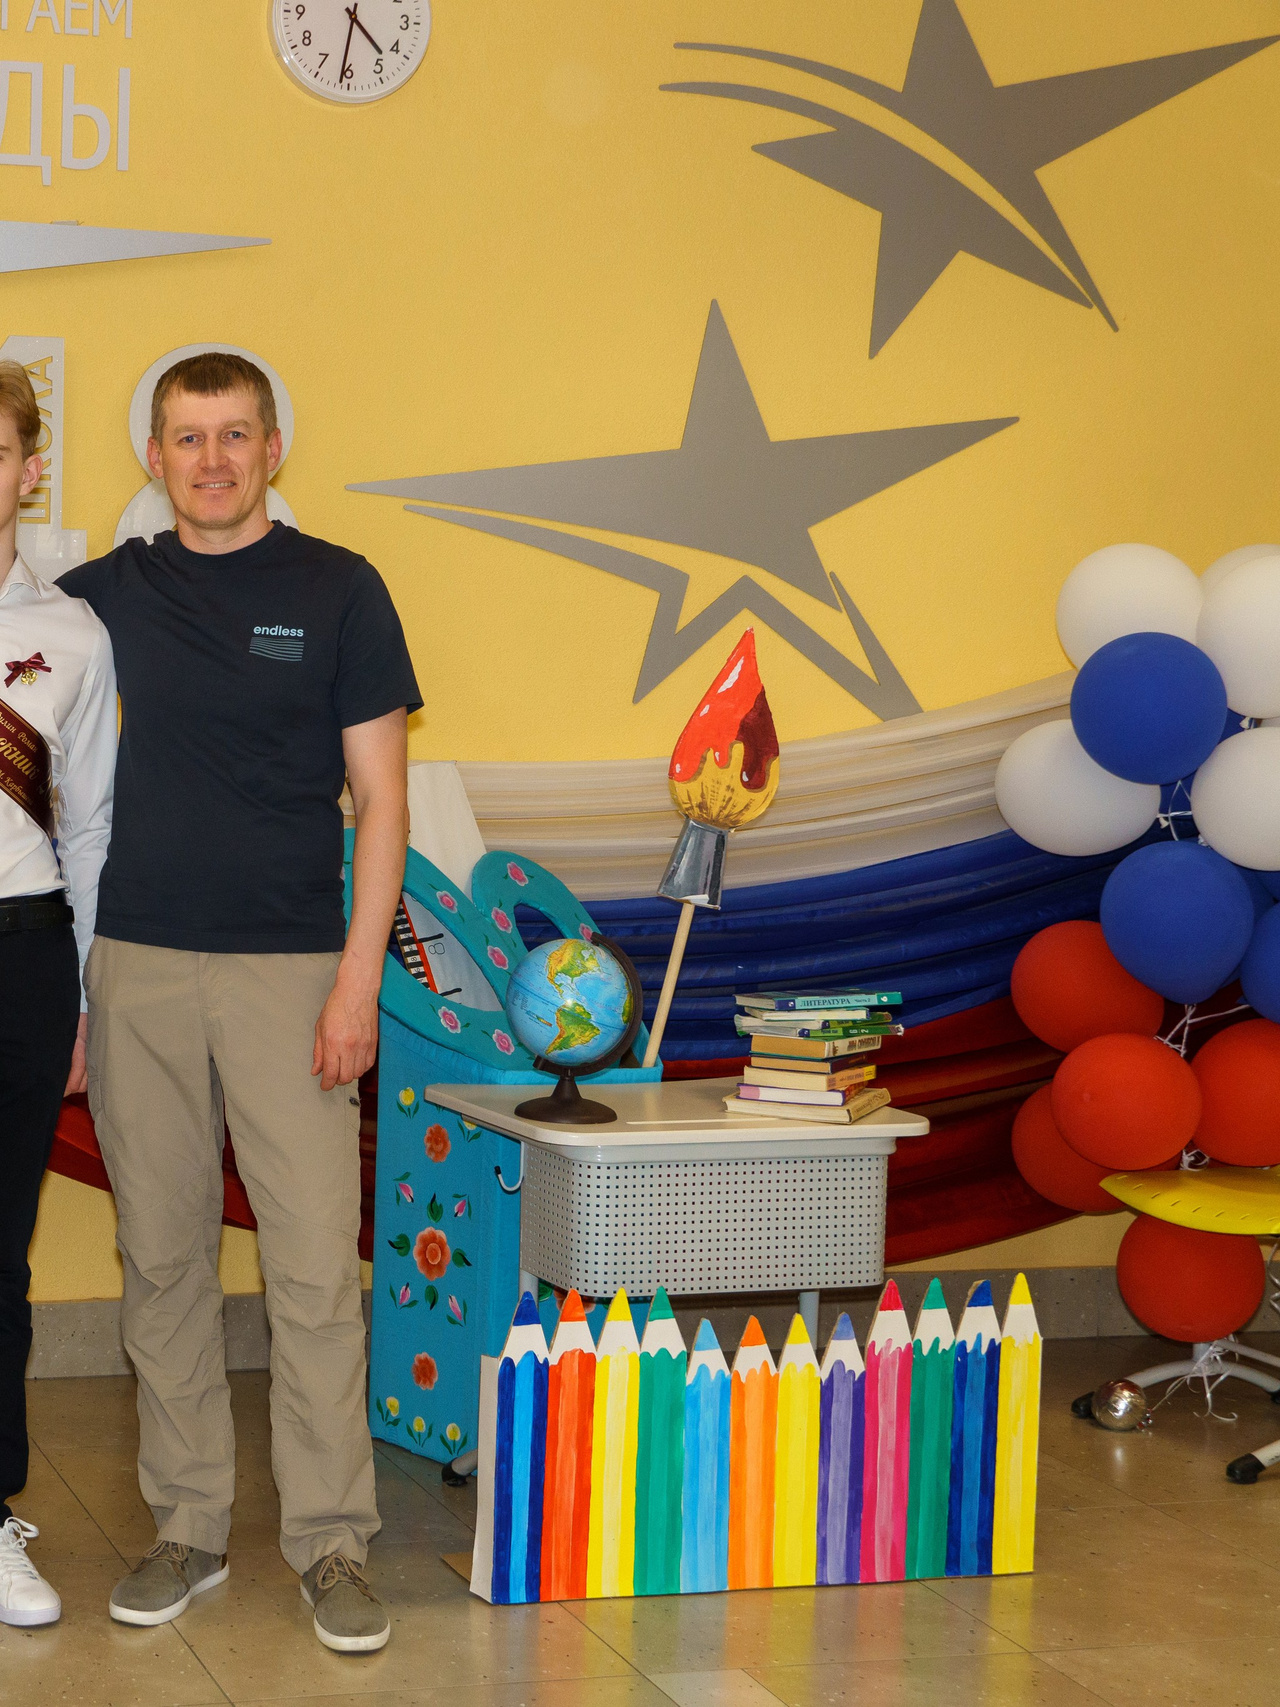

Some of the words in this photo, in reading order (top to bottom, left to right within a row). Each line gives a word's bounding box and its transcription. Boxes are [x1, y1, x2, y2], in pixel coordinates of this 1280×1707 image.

[295, 4, 306, 21] 9
[399, 14, 410, 31] 3
[302, 30, 312, 46] 8
[389, 38, 400, 55] 4
[318, 53, 330, 69] 7
[373, 58, 384, 74] 5
[342, 63, 354, 79] 6
[253, 625, 304, 637] endless
[17, 732, 38, 752] Роман
[4, 777, 33, 806] Карбыш
[800, 998, 851, 1007] ЛИТЕРАТУРА
